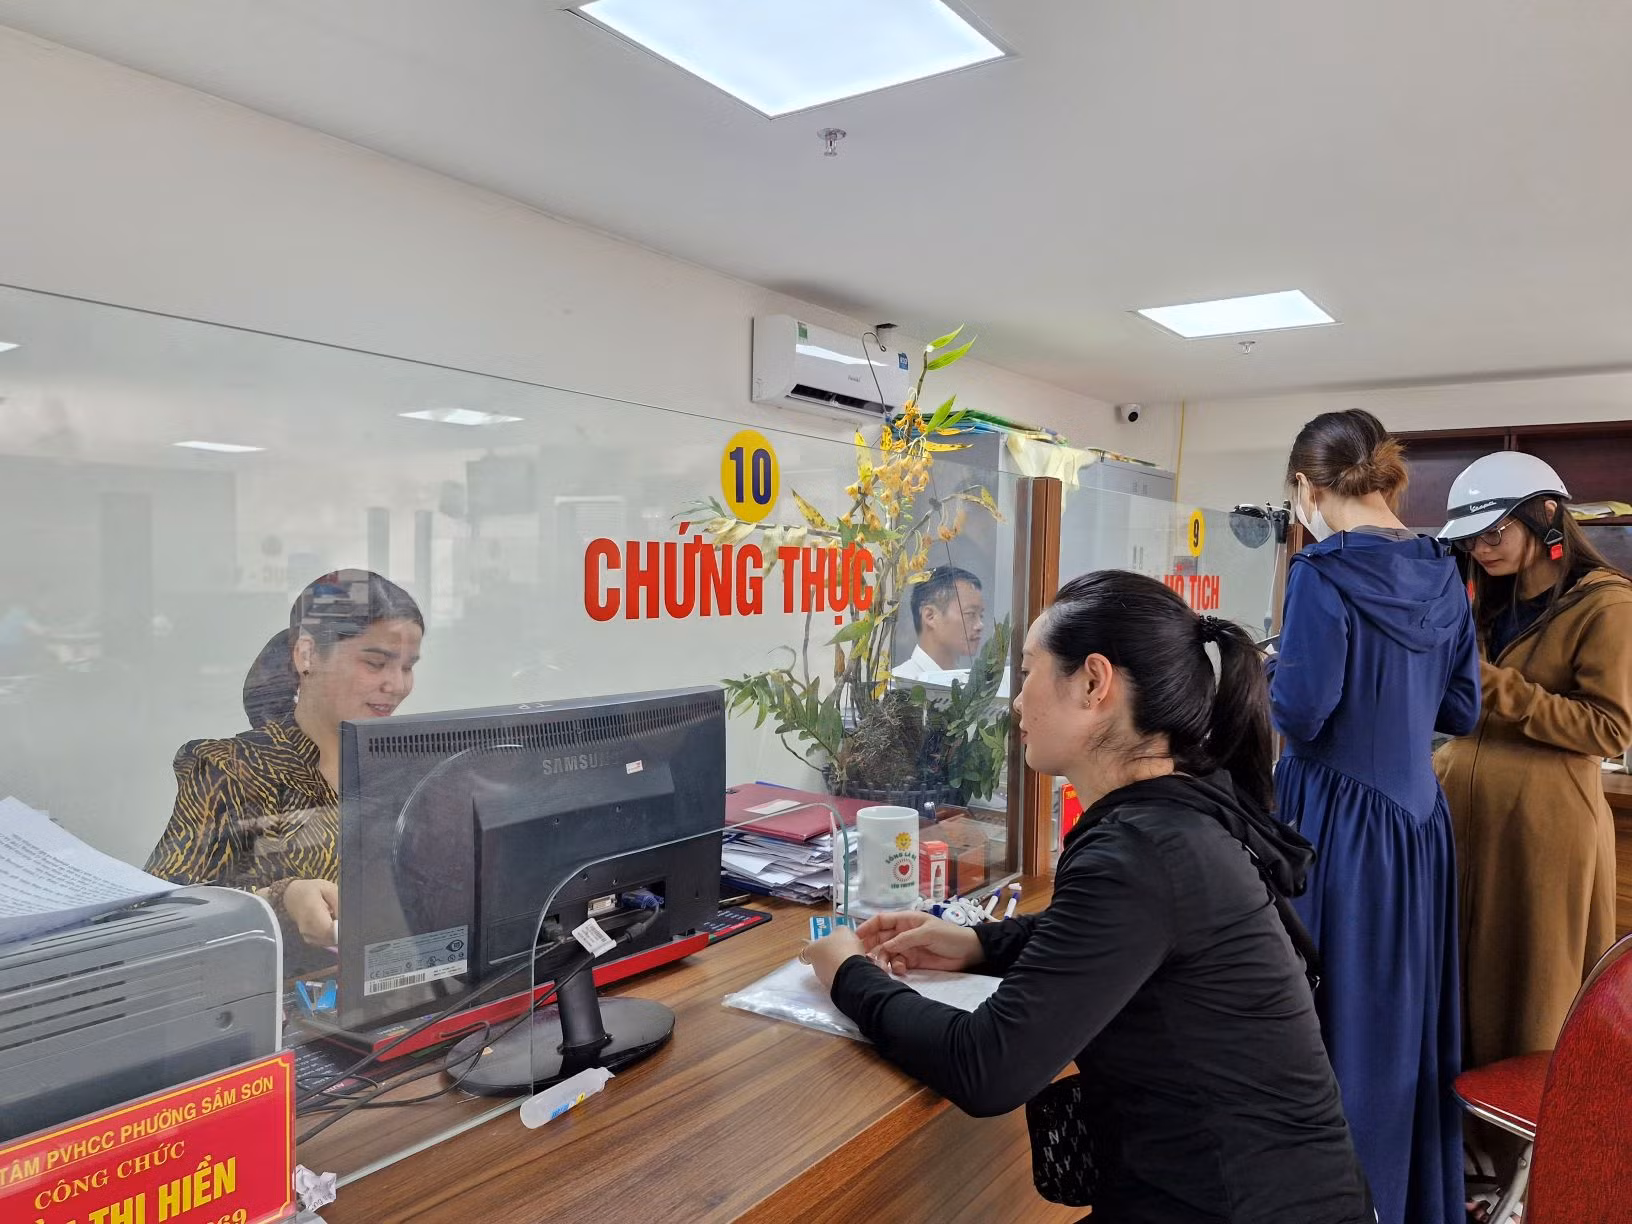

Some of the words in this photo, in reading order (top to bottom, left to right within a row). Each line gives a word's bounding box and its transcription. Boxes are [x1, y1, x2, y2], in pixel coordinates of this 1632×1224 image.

[729, 446, 772, 505] 10
[1193, 518, 1200, 548] 9
[584, 521, 764, 622] CHỨNG
[778, 541, 875, 626] THỰC
[47, 1129, 115, 1170] PVHCC
[120, 1102, 197, 1142] PHƯỜNG
[201, 1087, 236, 1114] SẦM
[241, 1075, 274, 1100] SƠN
[34, 1168, 110, 1210] CÔNG
[117, 1140, 185, 1179] CHỨC
[158, 1154, 236, 1223] HIỀN
